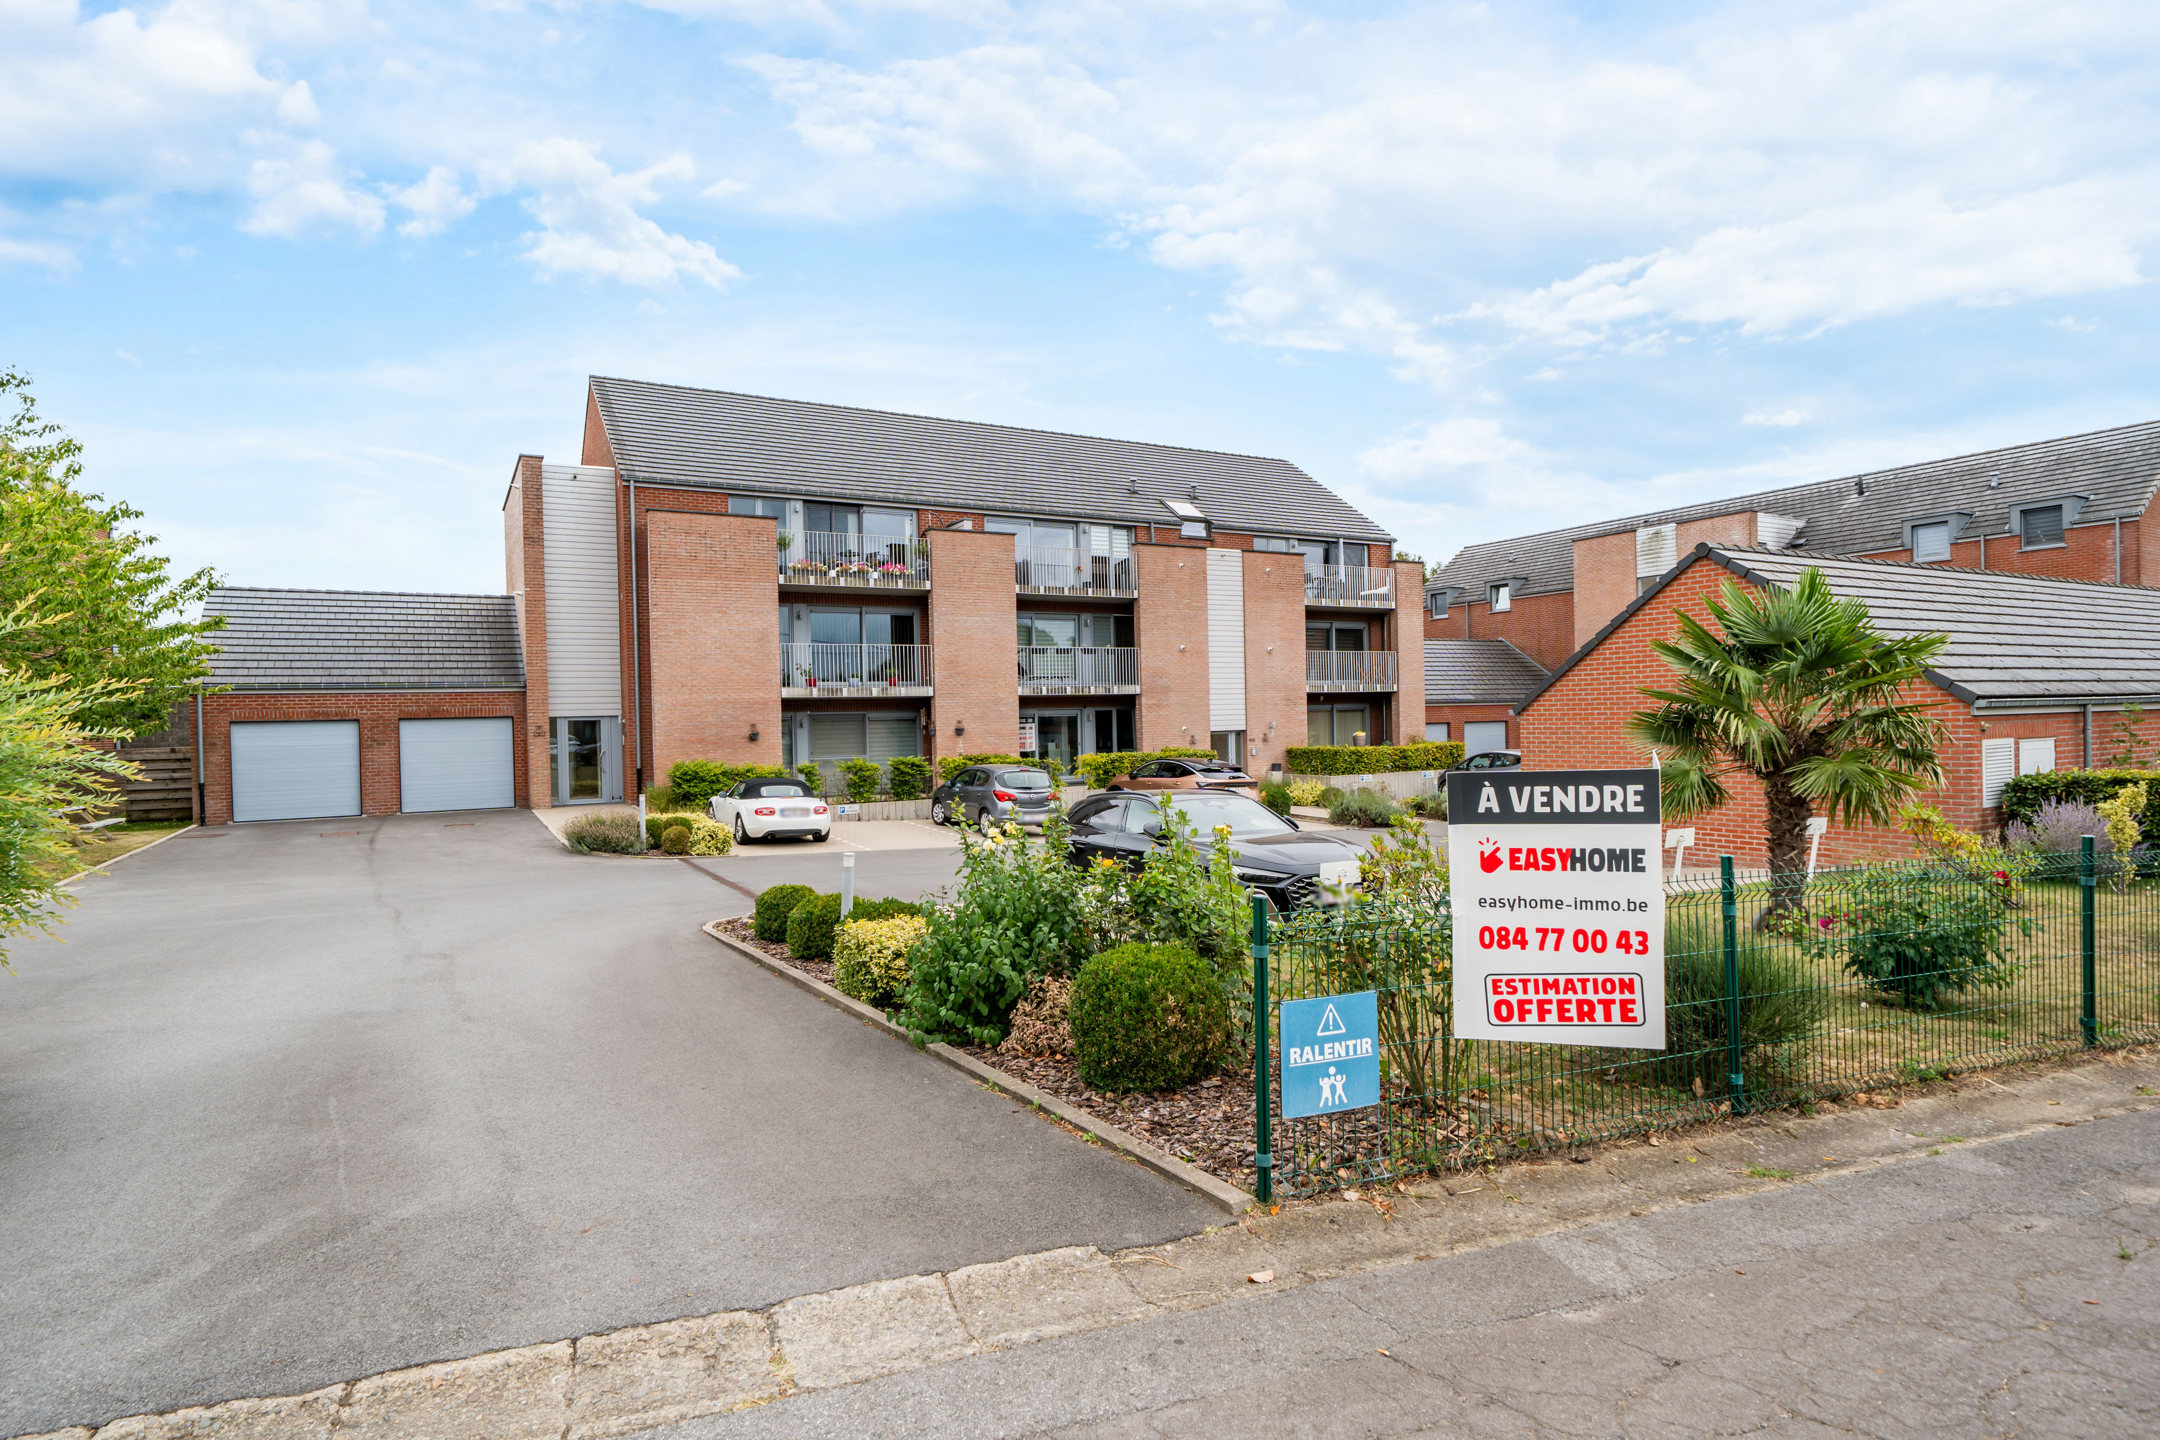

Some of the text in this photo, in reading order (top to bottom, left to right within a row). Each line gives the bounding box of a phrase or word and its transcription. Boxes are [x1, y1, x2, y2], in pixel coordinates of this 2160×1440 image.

[1478, 781, 1645, 813] À VENDRE
[1509, 848, 1646, 872] EASYHOME
[1479, 895, 1648, 912] easyhome-immo.be
[1479, 926, 1649, 955] 084 77 00 43
[1491, 977, 1635, 995] ESTIMATION
[1493, 998, 1638, 1023] OFFERTE
[1289, 1037, 1373, 1064] RALENTIR
